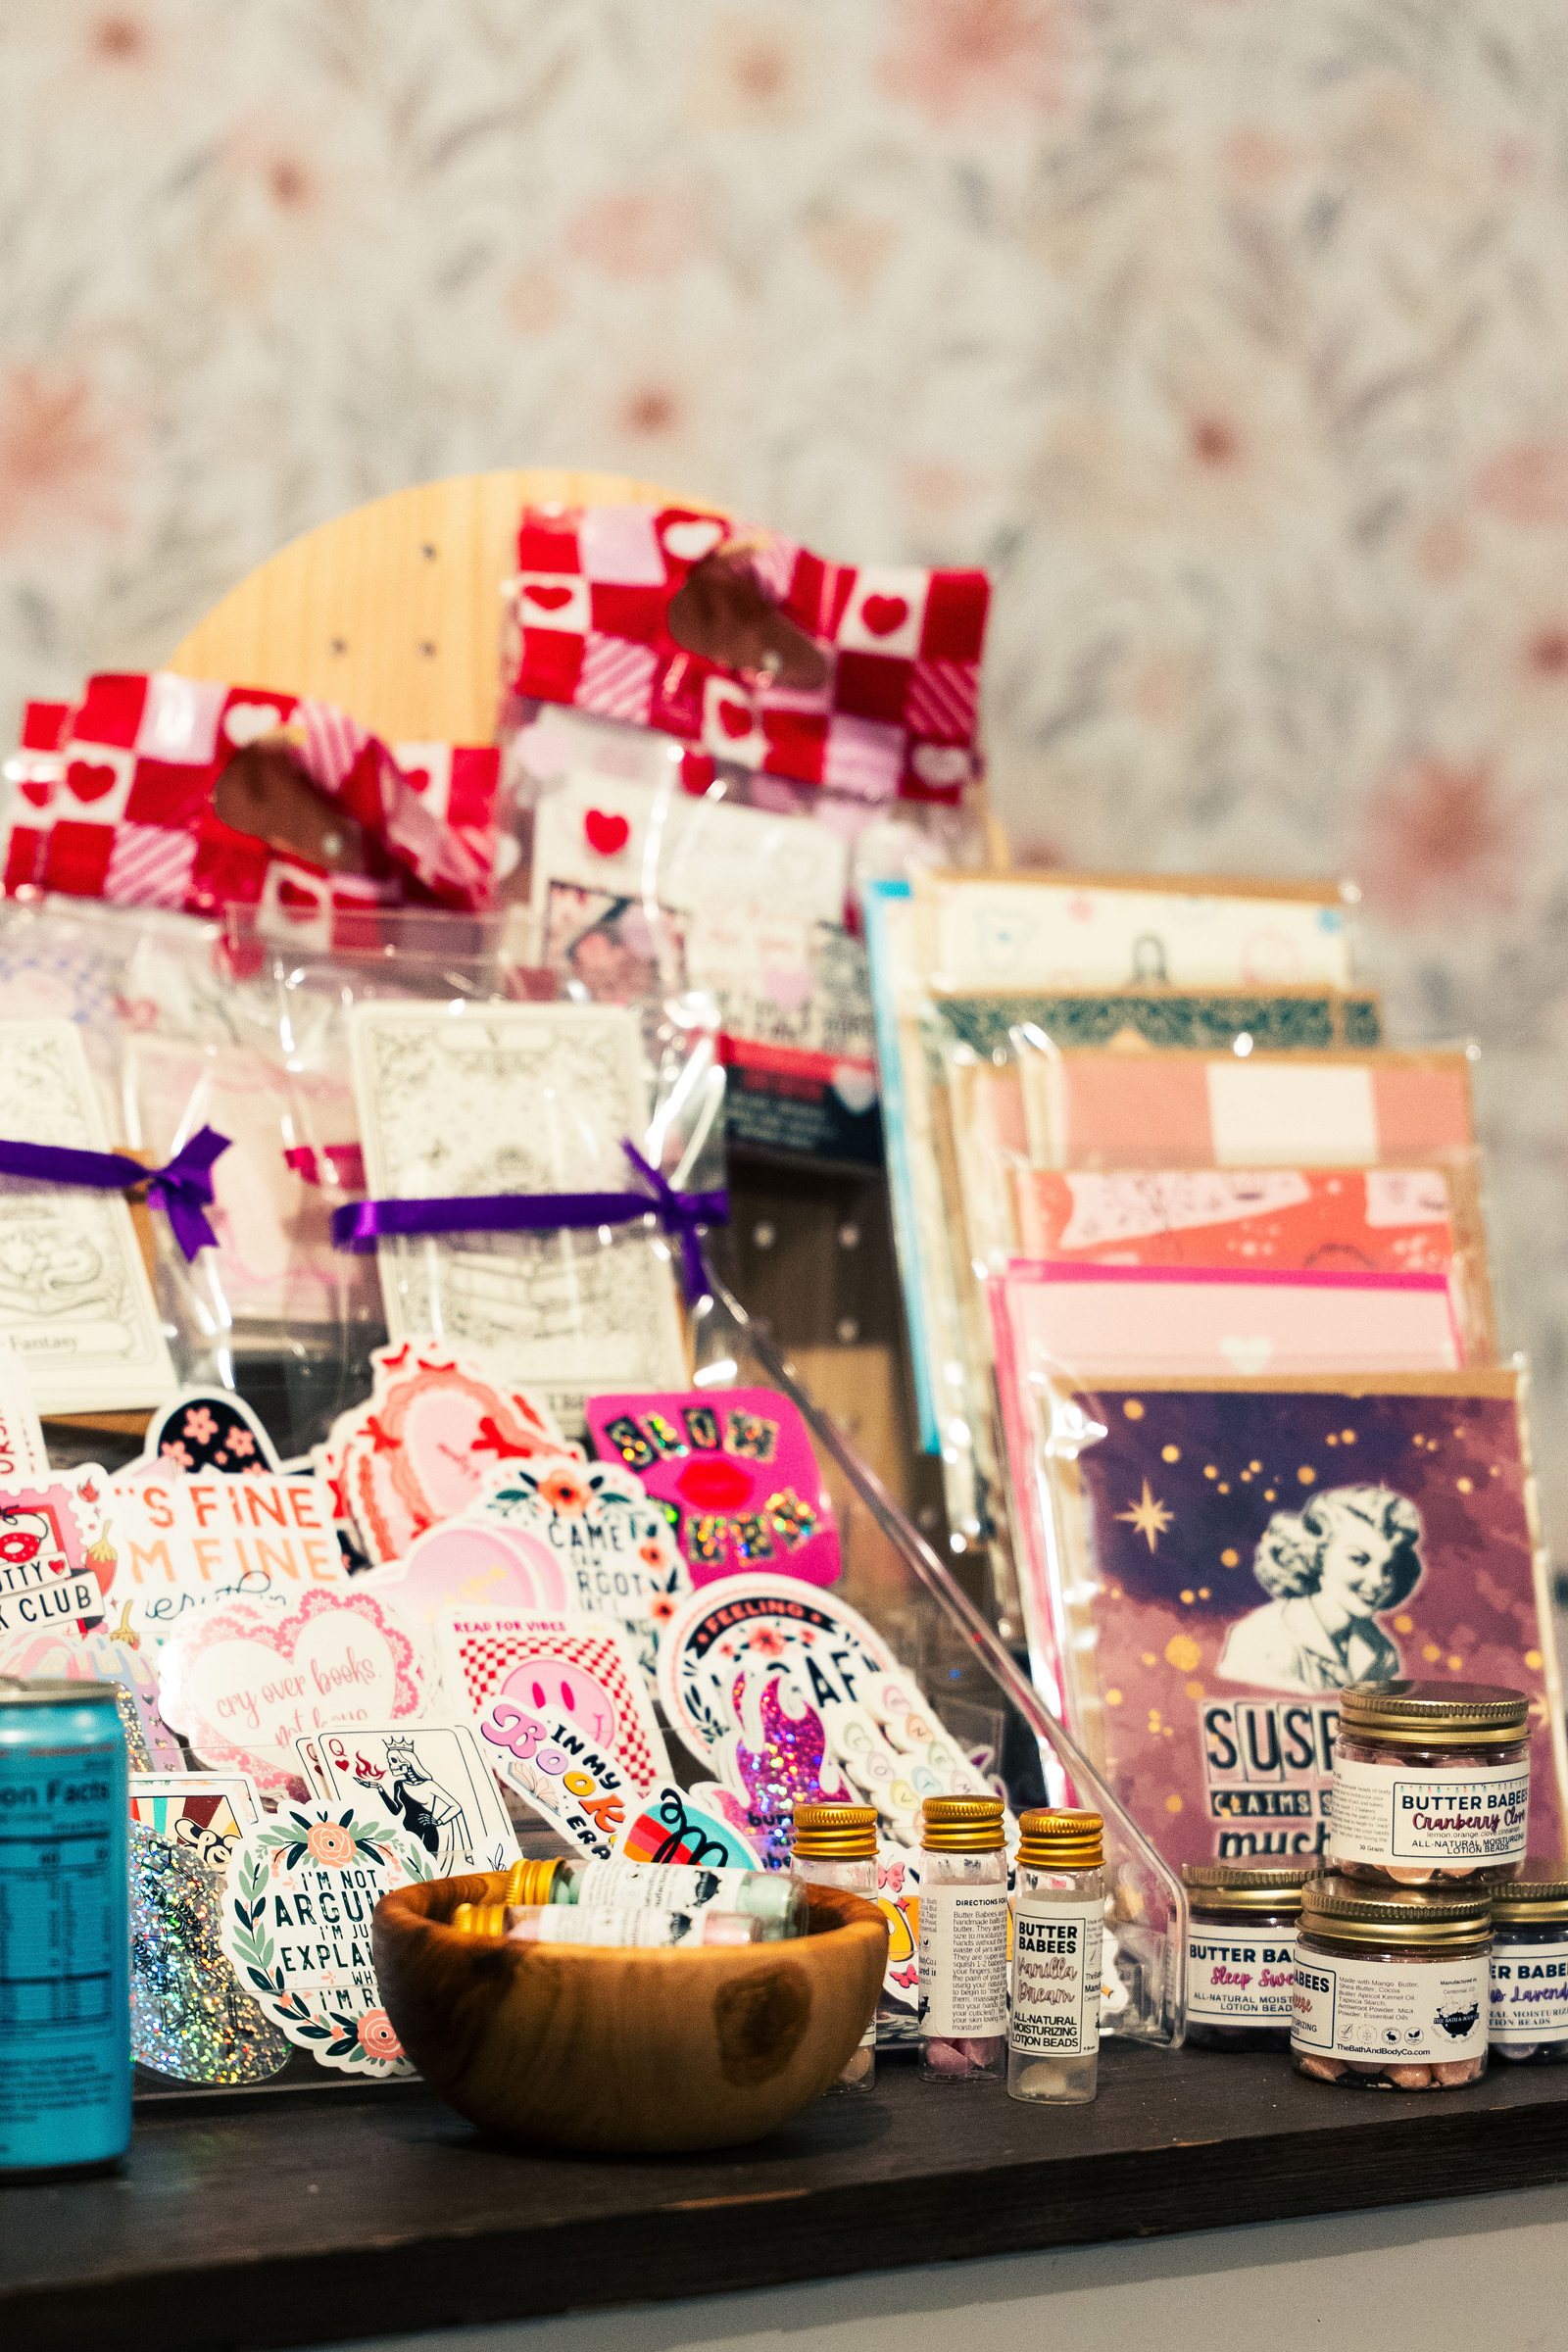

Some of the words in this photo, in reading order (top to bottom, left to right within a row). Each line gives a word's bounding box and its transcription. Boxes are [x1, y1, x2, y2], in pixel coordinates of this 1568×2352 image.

[187, 1486, 322, 1529] FINE
[192, 1539, 338, 1583] FINE
[19, 1585, 92, 1623] CLUB
[704, 1598, 806, 1634] FEELING
[454, 1622, 491, 1633] READ
[496, 1621, 523, 1632] FOR
[527, 1621, 565, 1632] VIBES
[217, 1690, 260, 1730] cry
[262, 1674, 306, 1703] over
[310, 1646, 377, 1695] books
[805, 1651, 858, 1708] AF
[328, 1739, 347, 1757] Q
[551, 1723, 585, 1756] IN
[582, 1754, 621, 1790] MY
[480, 1703, 626, 1834] BOOK
[1214, 1792, 1310, 1814] CLAIMS
[1401, 1795, 1483, 1811] BUTTER
[1412, 1812, 1500, 1835] Cranberry
[565, 1815, 612, 1861] ERA
[1411, 1839, 1479, 1848] ALL-NATURAL
[1446, 1846, 1483, 1855] LOTION
[1484, 1843, 1509, 1853] BEADS
[301, 1871, 332, 1891] I'M
[340, 1870, 377, 1889] NOT
[275, 1889, 394, 1928] ARGUI
[956, 1898, 998, 1907] DIRECTIONS
[319, 1925, 344, 1940] I'M
[353, 1924, 373, 1939] JU
[1019, 1921, 1077, 1938] BUTTER
[1018, 1936, 1076, 1954] BABEES
[1189, 1944, 1256, 1963] BUTTER
[352, 1971, 376, 1985] WH
[1017, 1956, 1078, 1982] Vanilla
[1210, 1965, 1253, 1991] Sleep
[1518, 1963, 1568, 1980] BABE
[319, 1989, 353, 2011] I'M
[1194, 1992, 1255, 2003] ALL-NATURAL
[1220, 2003, 1258, 2012] LOTION
[1013, 2012, 1077, 2026] ALL-NATURAL
[1013, 2022, 1078, 2036] MOISTURIZING
[1012, 2034, 1041, 2046] LOTION
[1043, 2037, 1079, 2048] BEADS
[1337, 2043, 1431, 2057] TheBathAndBodyCo.com
